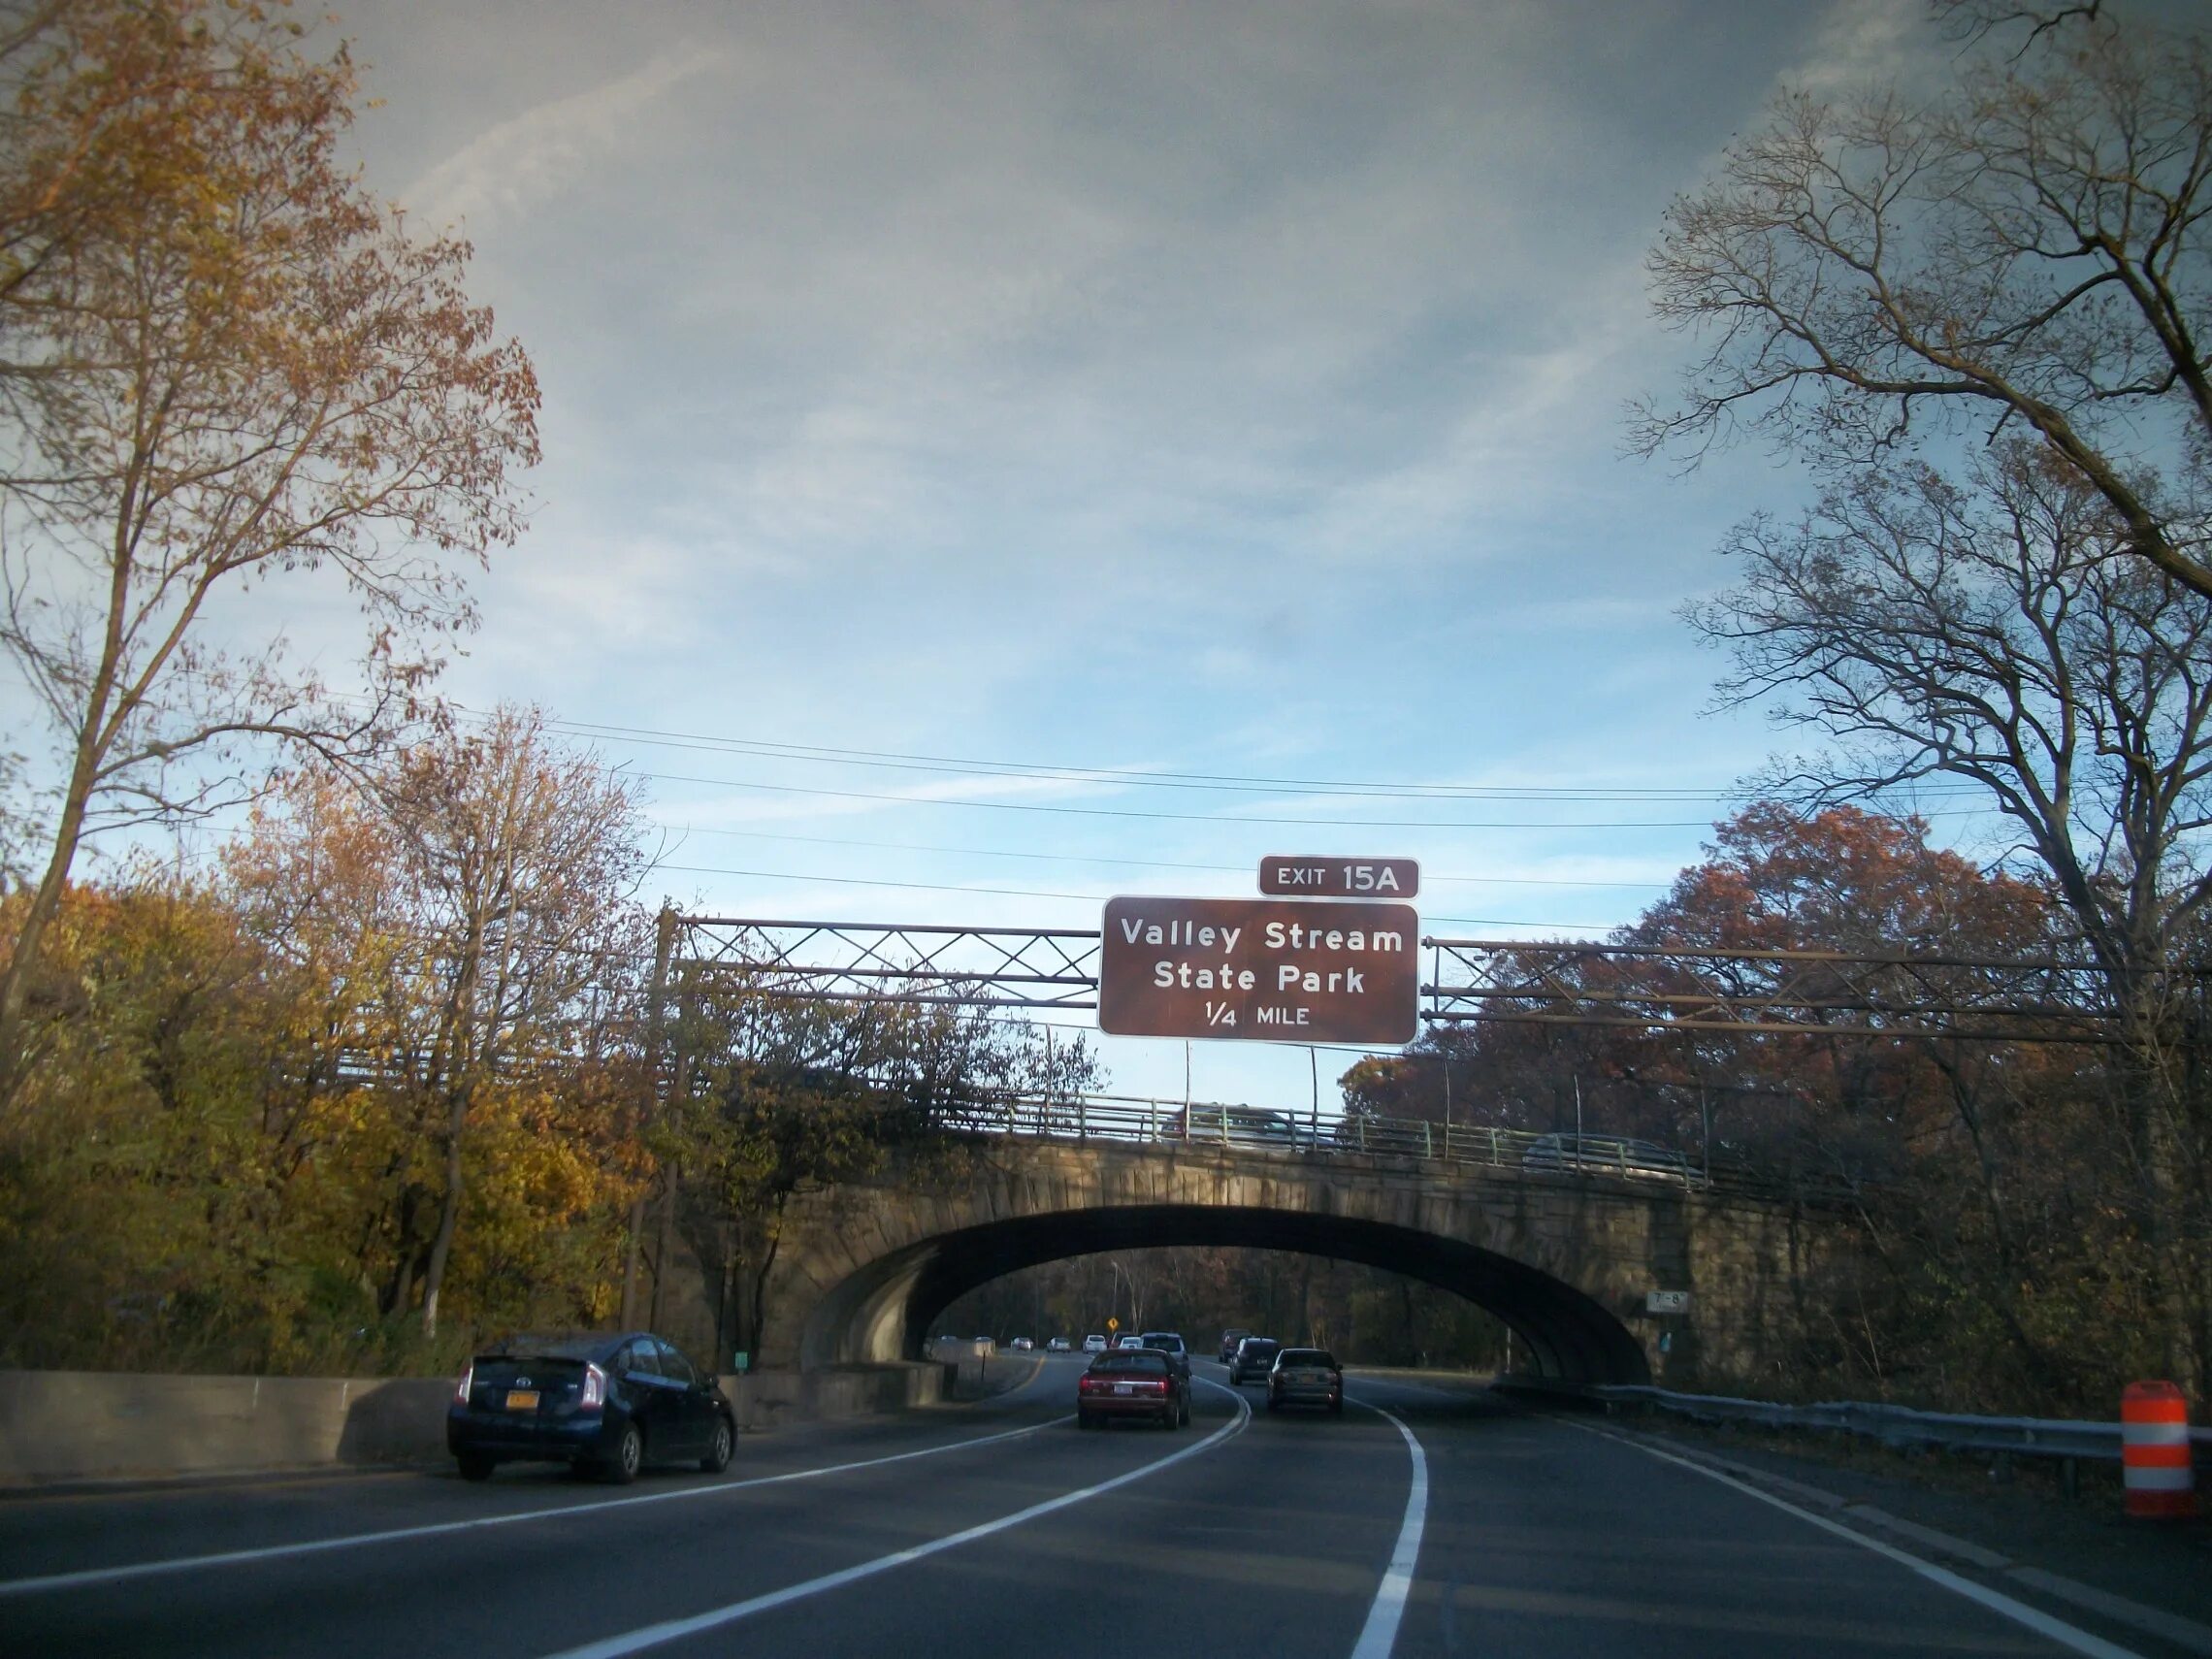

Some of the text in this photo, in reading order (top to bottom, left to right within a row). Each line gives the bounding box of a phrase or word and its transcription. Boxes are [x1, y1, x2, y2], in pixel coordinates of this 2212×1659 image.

[1278, 865, 1399, 891] EXIT 15A
[1121, 918, 1402, 955] Valley Stream
[1154, 960, 1365, 993] State Park
[1257, 1007, 1310, 1025] MILE
